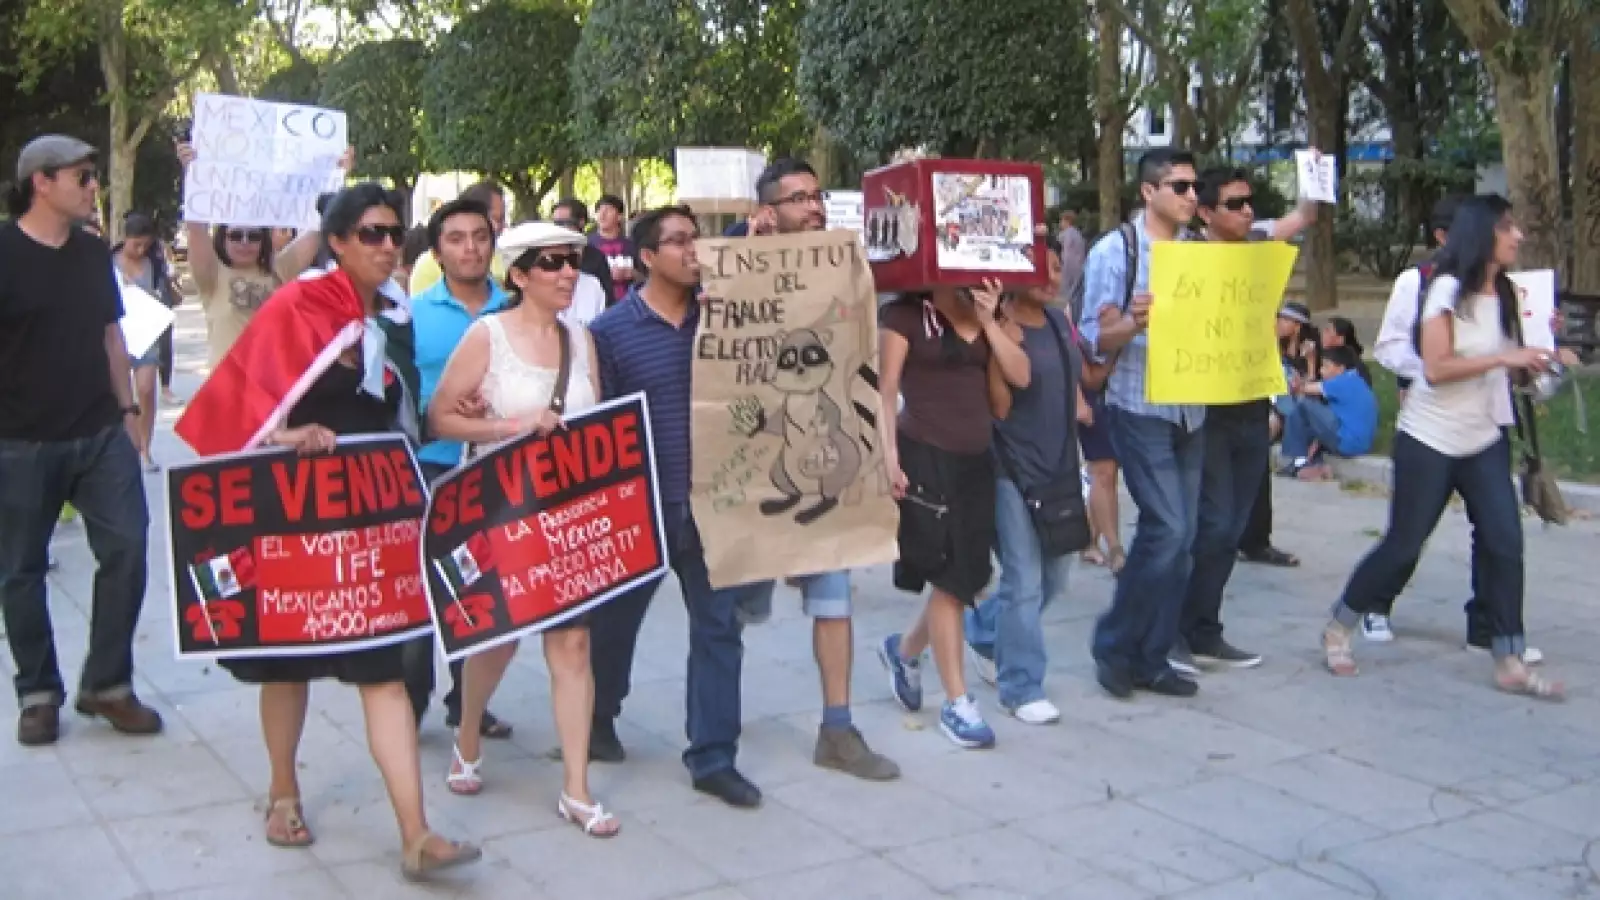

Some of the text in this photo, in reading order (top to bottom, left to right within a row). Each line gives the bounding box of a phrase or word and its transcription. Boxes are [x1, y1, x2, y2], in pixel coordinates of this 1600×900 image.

[202, 100, 337, 140] MEXICO
[196, 128, 251, 161] NO
[773, 272, 808, 294] DEL
[702, 297, 785, 329] FRAUDE
[1204, 316, 1234, 339] NO
[495, 411, 642, 507] VENDE
[180, 467, 255, 530] SE
[271, 450, 422, 522] VENDE
[431, 468, 485, 535] SE
[260, 535, 290, 560] EL
[301, 530, 360, 556] VOTO
[503, 520, 533, 542] LA
[548, 517, 612, 557] MEXICO
[336, 546, 385, 583] IFE
[262, 581, 383, 615] MEXICANOS
